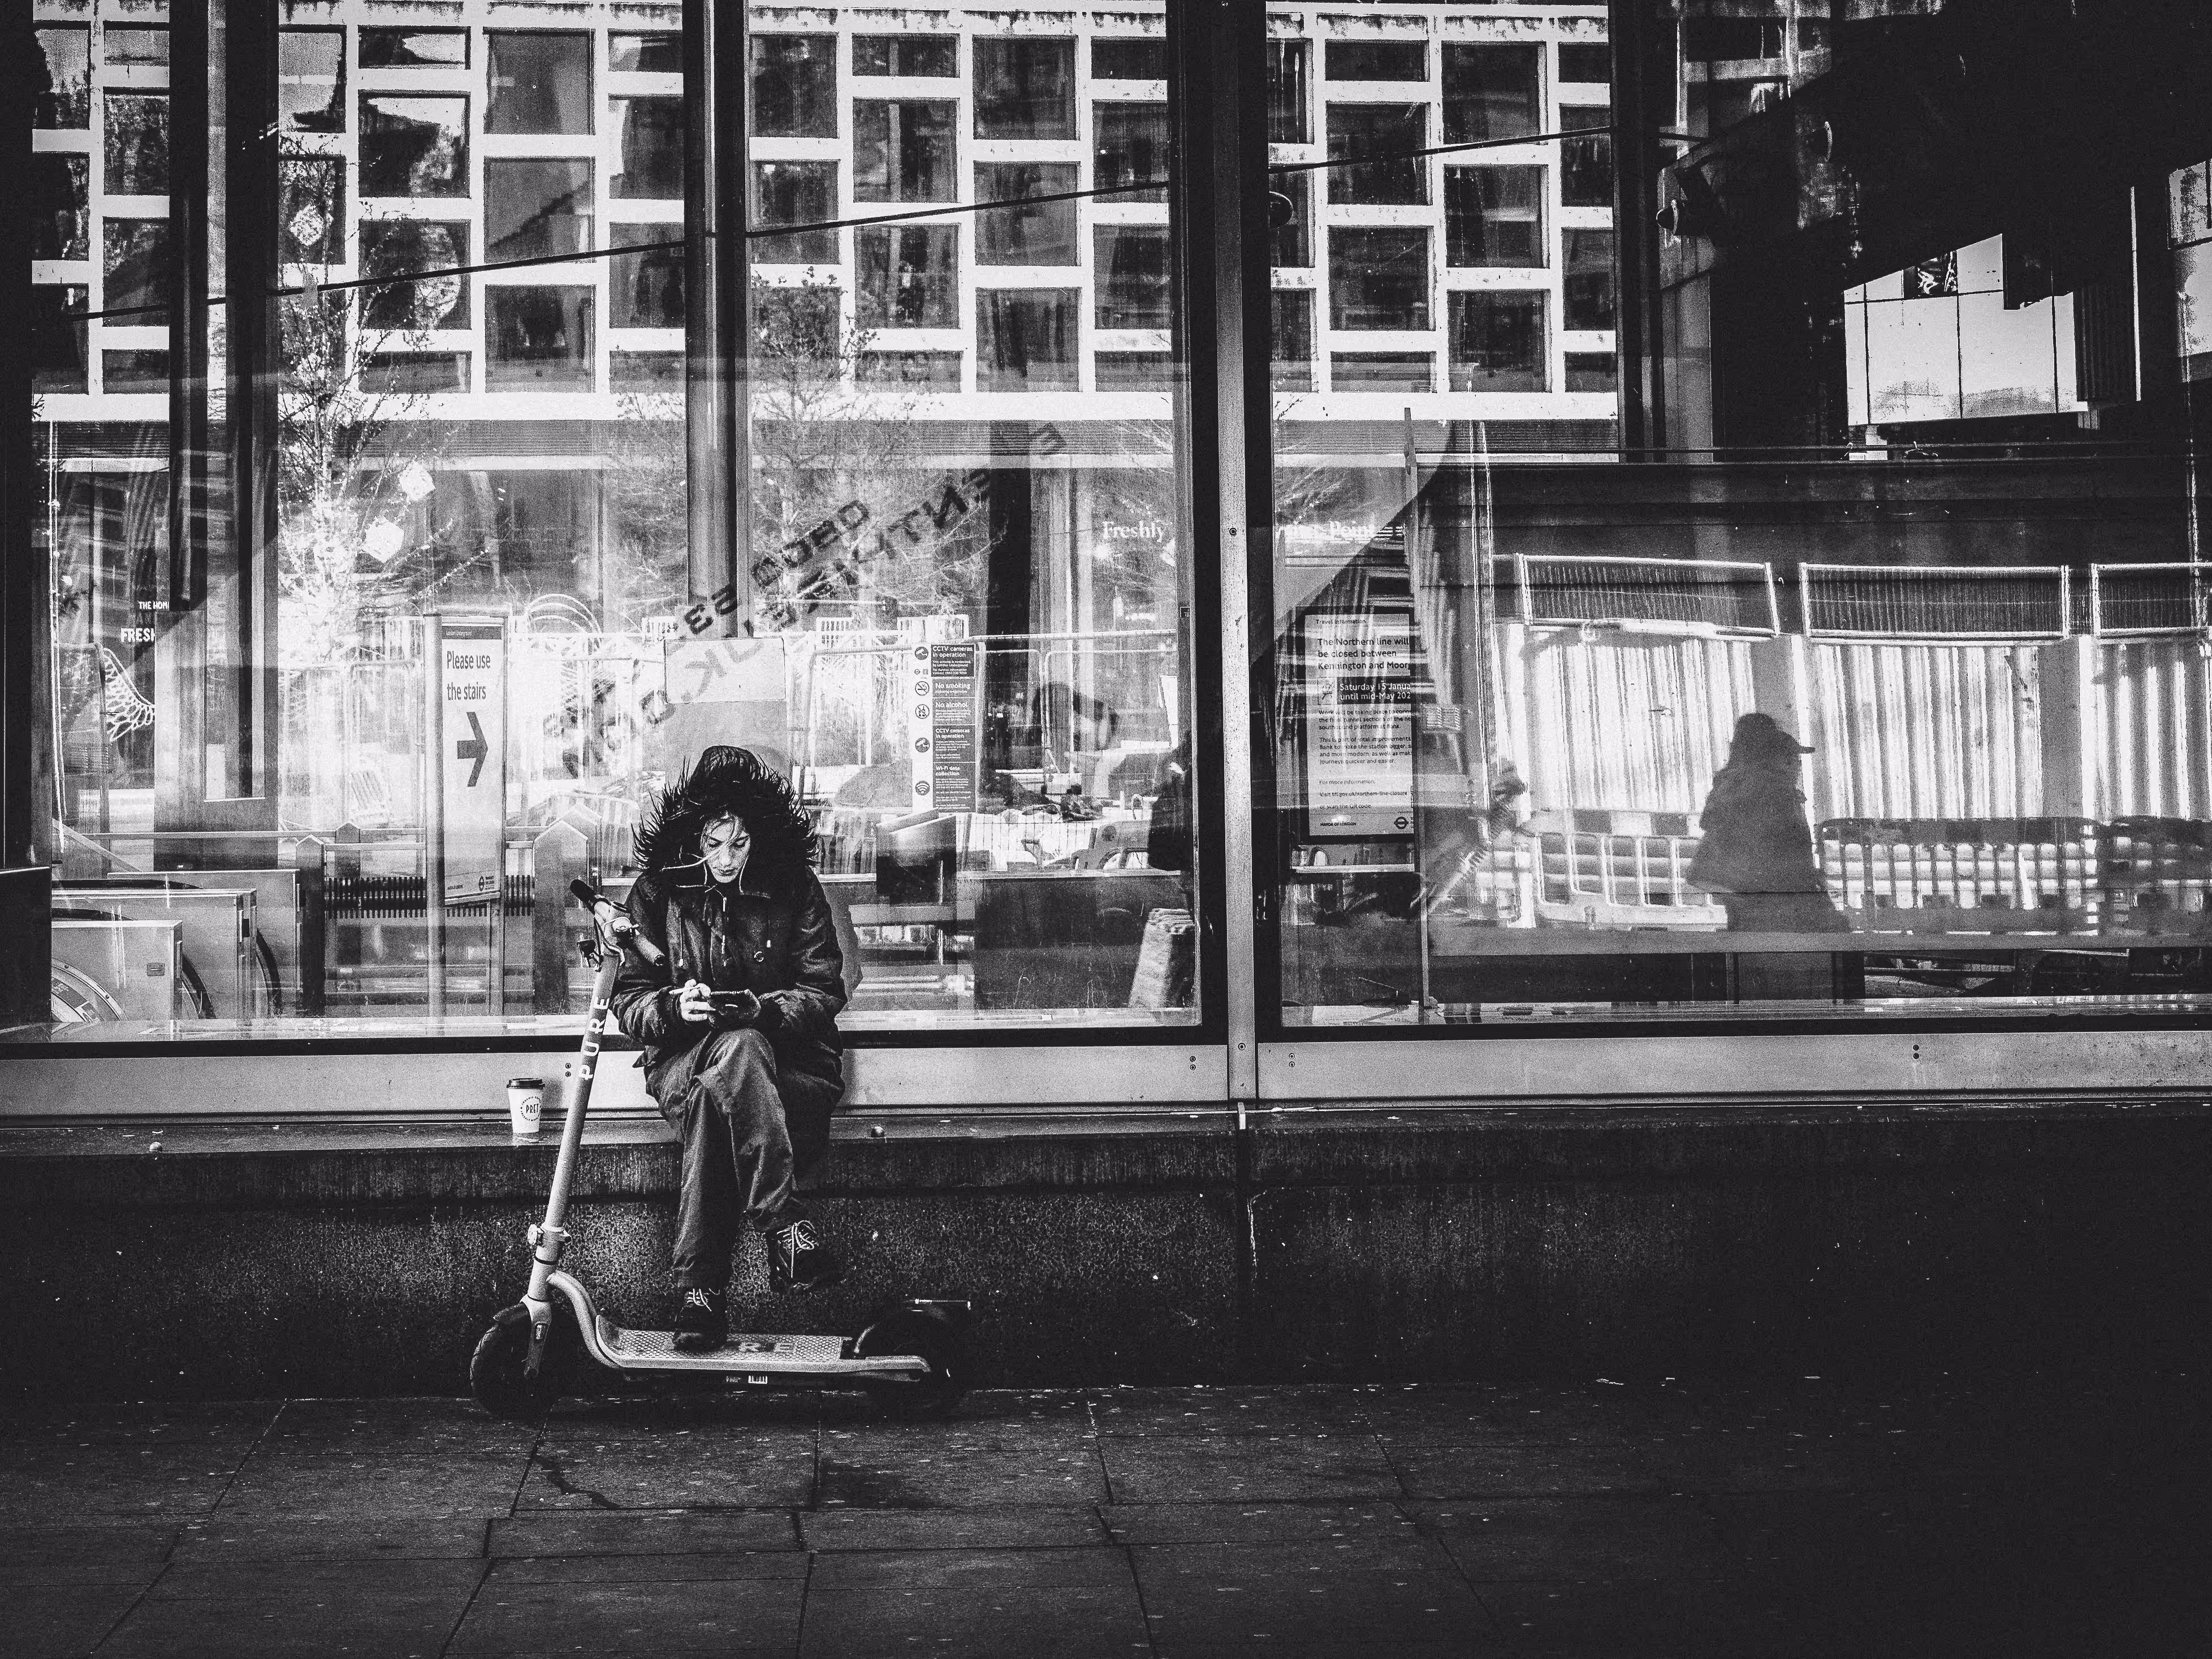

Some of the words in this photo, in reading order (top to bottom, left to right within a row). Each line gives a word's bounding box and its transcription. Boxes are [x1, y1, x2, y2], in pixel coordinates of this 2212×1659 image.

[138, 600, 152, 610] THE
[153, 600, 170, 610] HOM
[1377, 637, 1392, 646] line
[1394, 637, 1409, 646] will
[447, 650, 474, 669] Please
[476, 655, 491, 669] use
[1318, 662, 1367, 671] Kennington
[447, 681, 461, 701] the
[464, 681, 486, 700] stairs
[1340, 683, 1376, 692] Saturday
[1361, 693, 1395, 701] mid-May
[577, 997, 610, 1081] PURE
[526, 1103, 539, 1114] PRET
